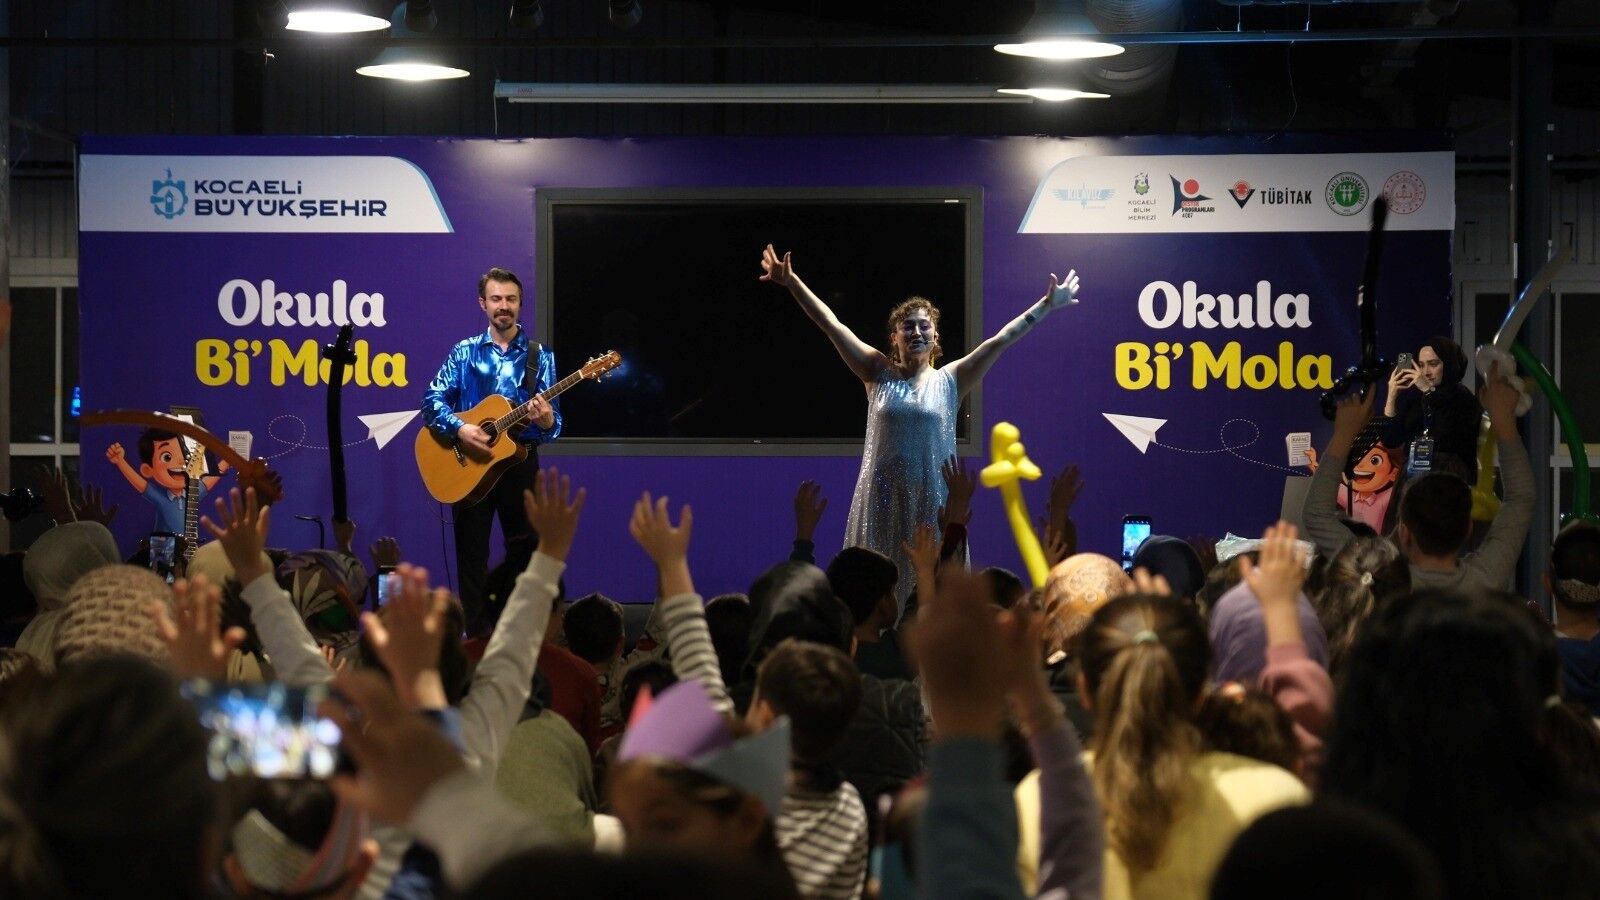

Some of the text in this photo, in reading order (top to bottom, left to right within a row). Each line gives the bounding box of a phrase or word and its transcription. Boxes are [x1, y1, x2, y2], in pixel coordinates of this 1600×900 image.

[1261, 187, 1312, 204] TÜBİTAK
[217, 279, 387, 327] Okula
[1138, 280, 1312, 329] Okula
[1190, 341, 1334, 391] Mola
